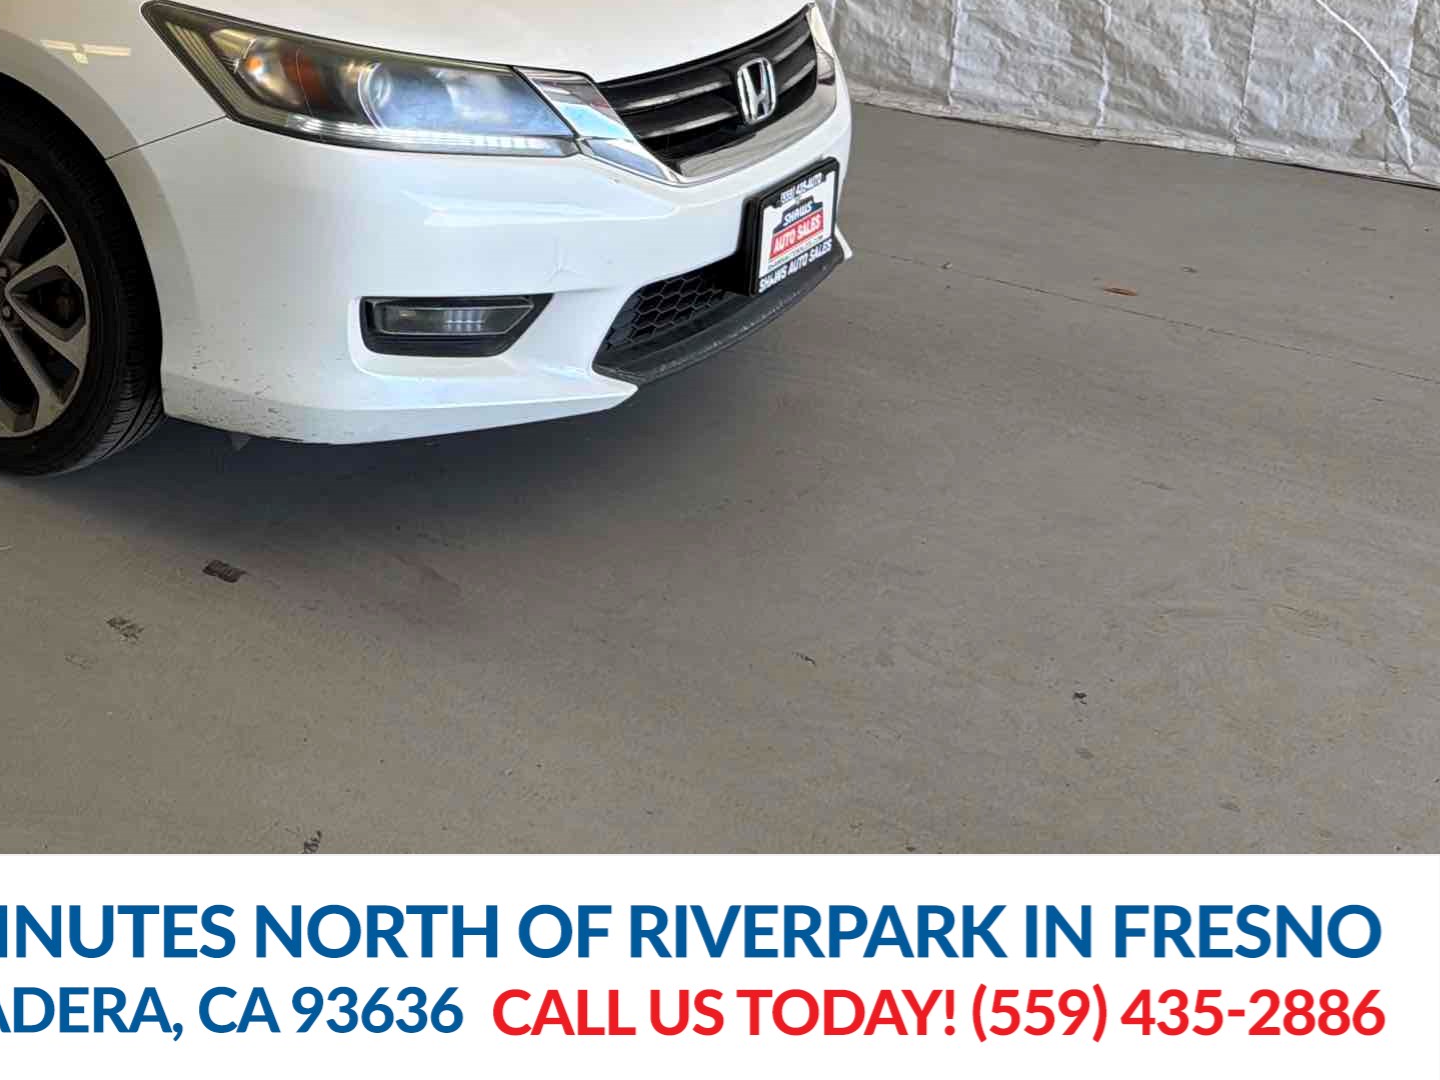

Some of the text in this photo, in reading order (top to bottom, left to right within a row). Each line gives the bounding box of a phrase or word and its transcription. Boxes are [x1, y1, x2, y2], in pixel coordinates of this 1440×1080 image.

[773, 228, 796, 254] AUTO
[796, 213, 822, 240] SALES
[787, 252, 809, 276] AUTO
[808, 237, 833, 263] SALES
